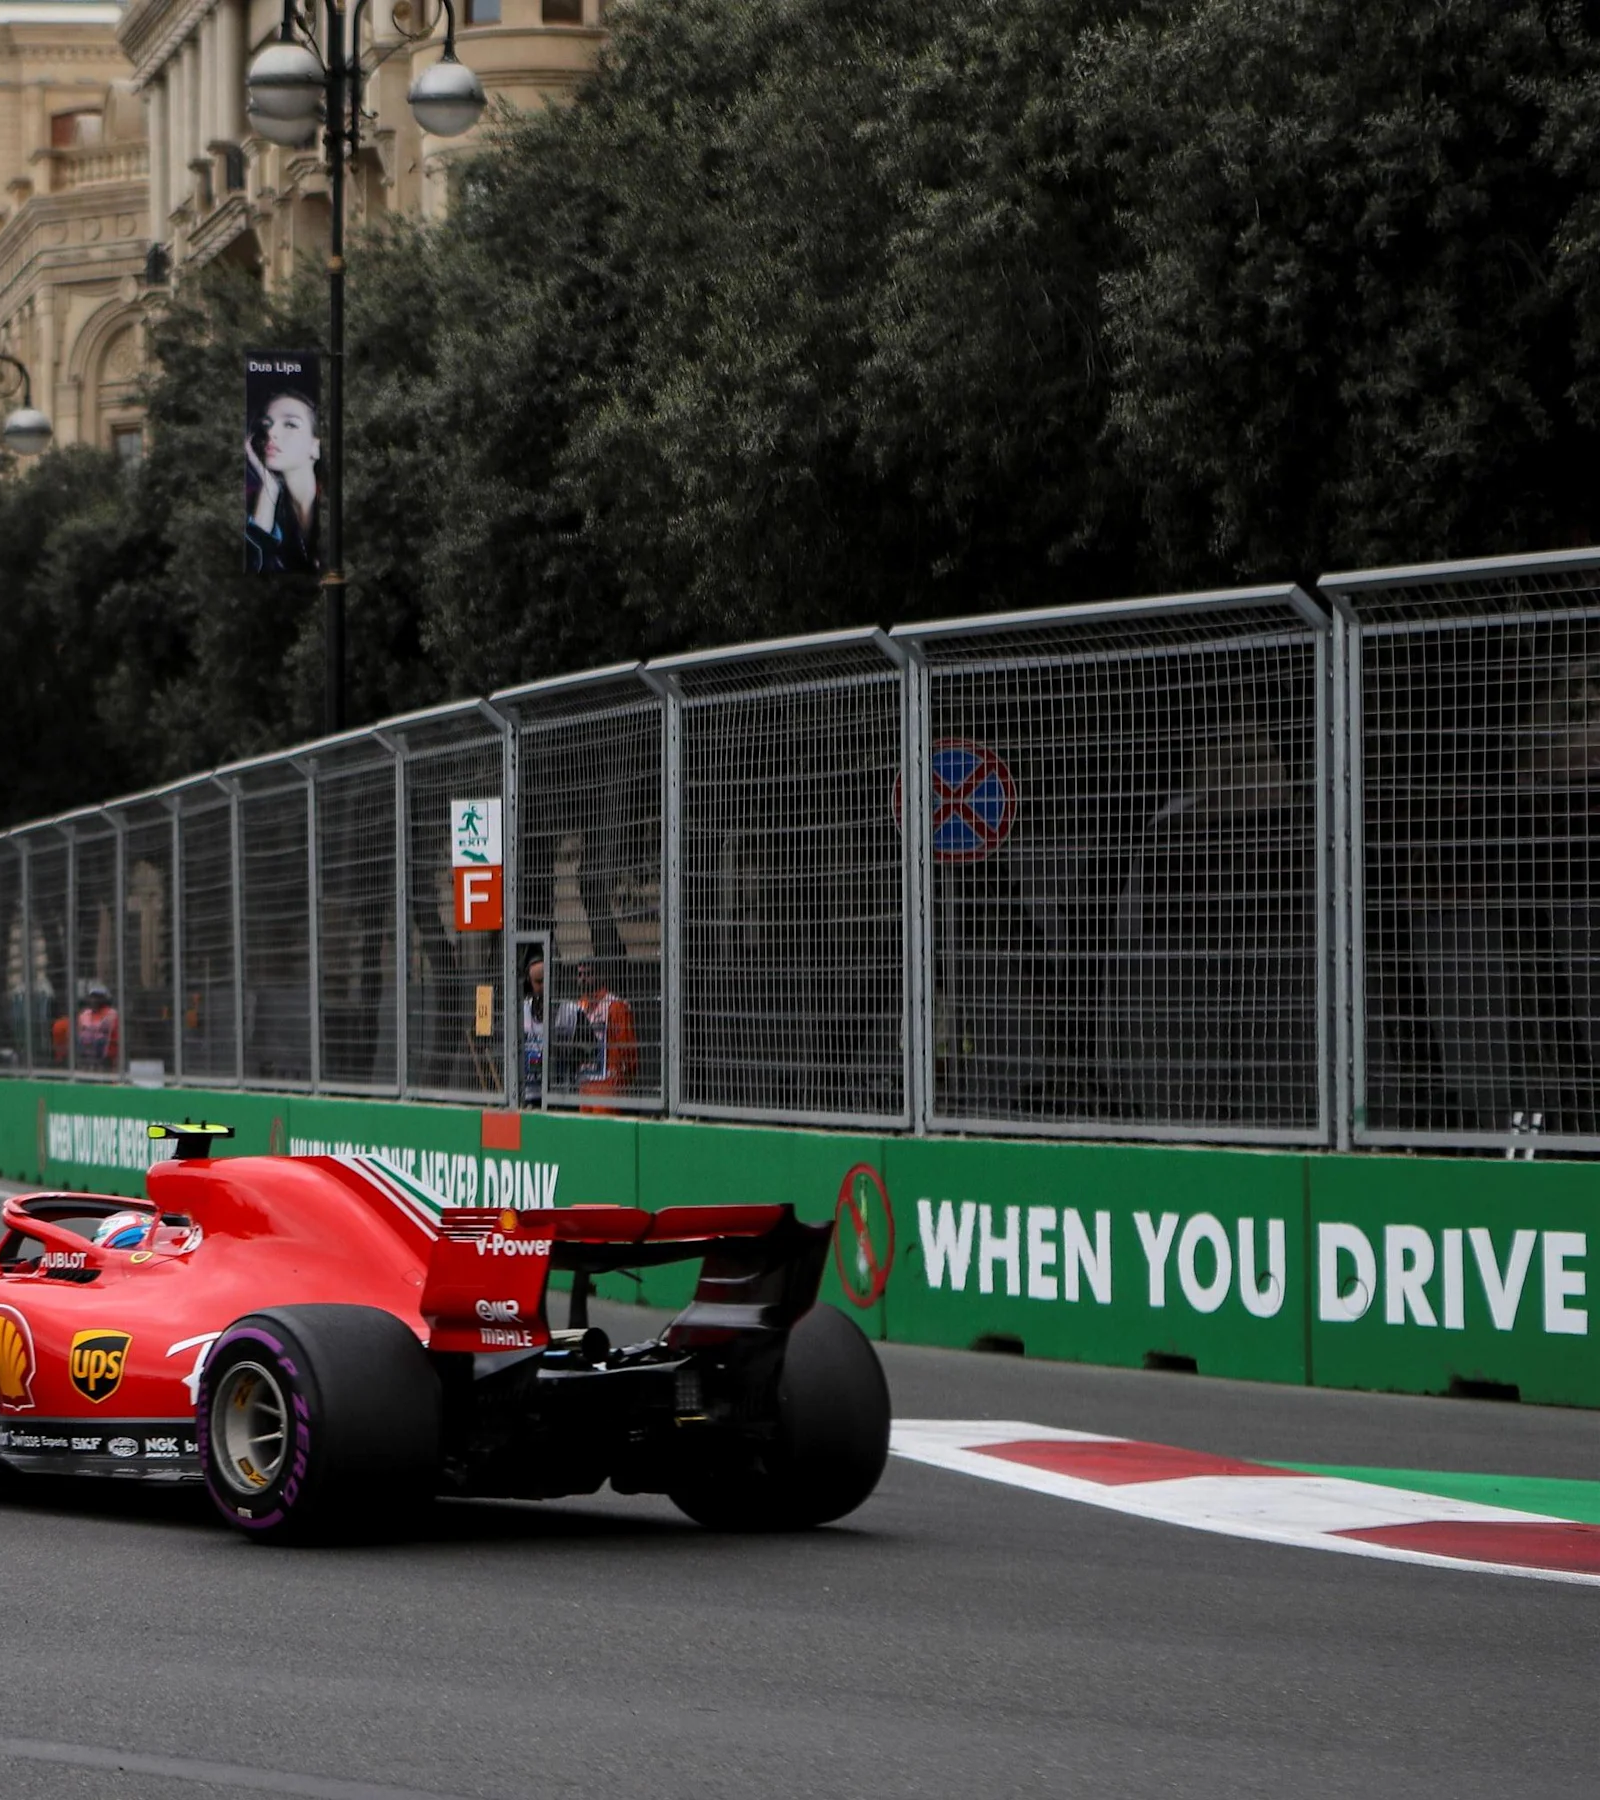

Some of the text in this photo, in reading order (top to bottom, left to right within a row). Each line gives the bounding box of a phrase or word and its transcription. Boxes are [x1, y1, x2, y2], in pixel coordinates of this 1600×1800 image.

[249, 361, 302, 375] Dua Lipa
[459, 837, 489, 847] EXIT
[463, 871, 493, 924] F
[421, 1150, 478, 1208] NEVER
[483, 1157, 559, 1209] DRINK
[476, 1233, 552, 1256] V-Power
[40, 1252, 87, 1269] HUBLOT
[917, 1199, 1588, 1336] WHEN YOU DRIVE
[480, 1328, 533, 1346] MAHLE
[73, 1349, 122, 1391] ups
[71, 1437, 102, 1450] SKF
[144, 1437, 179, 1452] NGK
